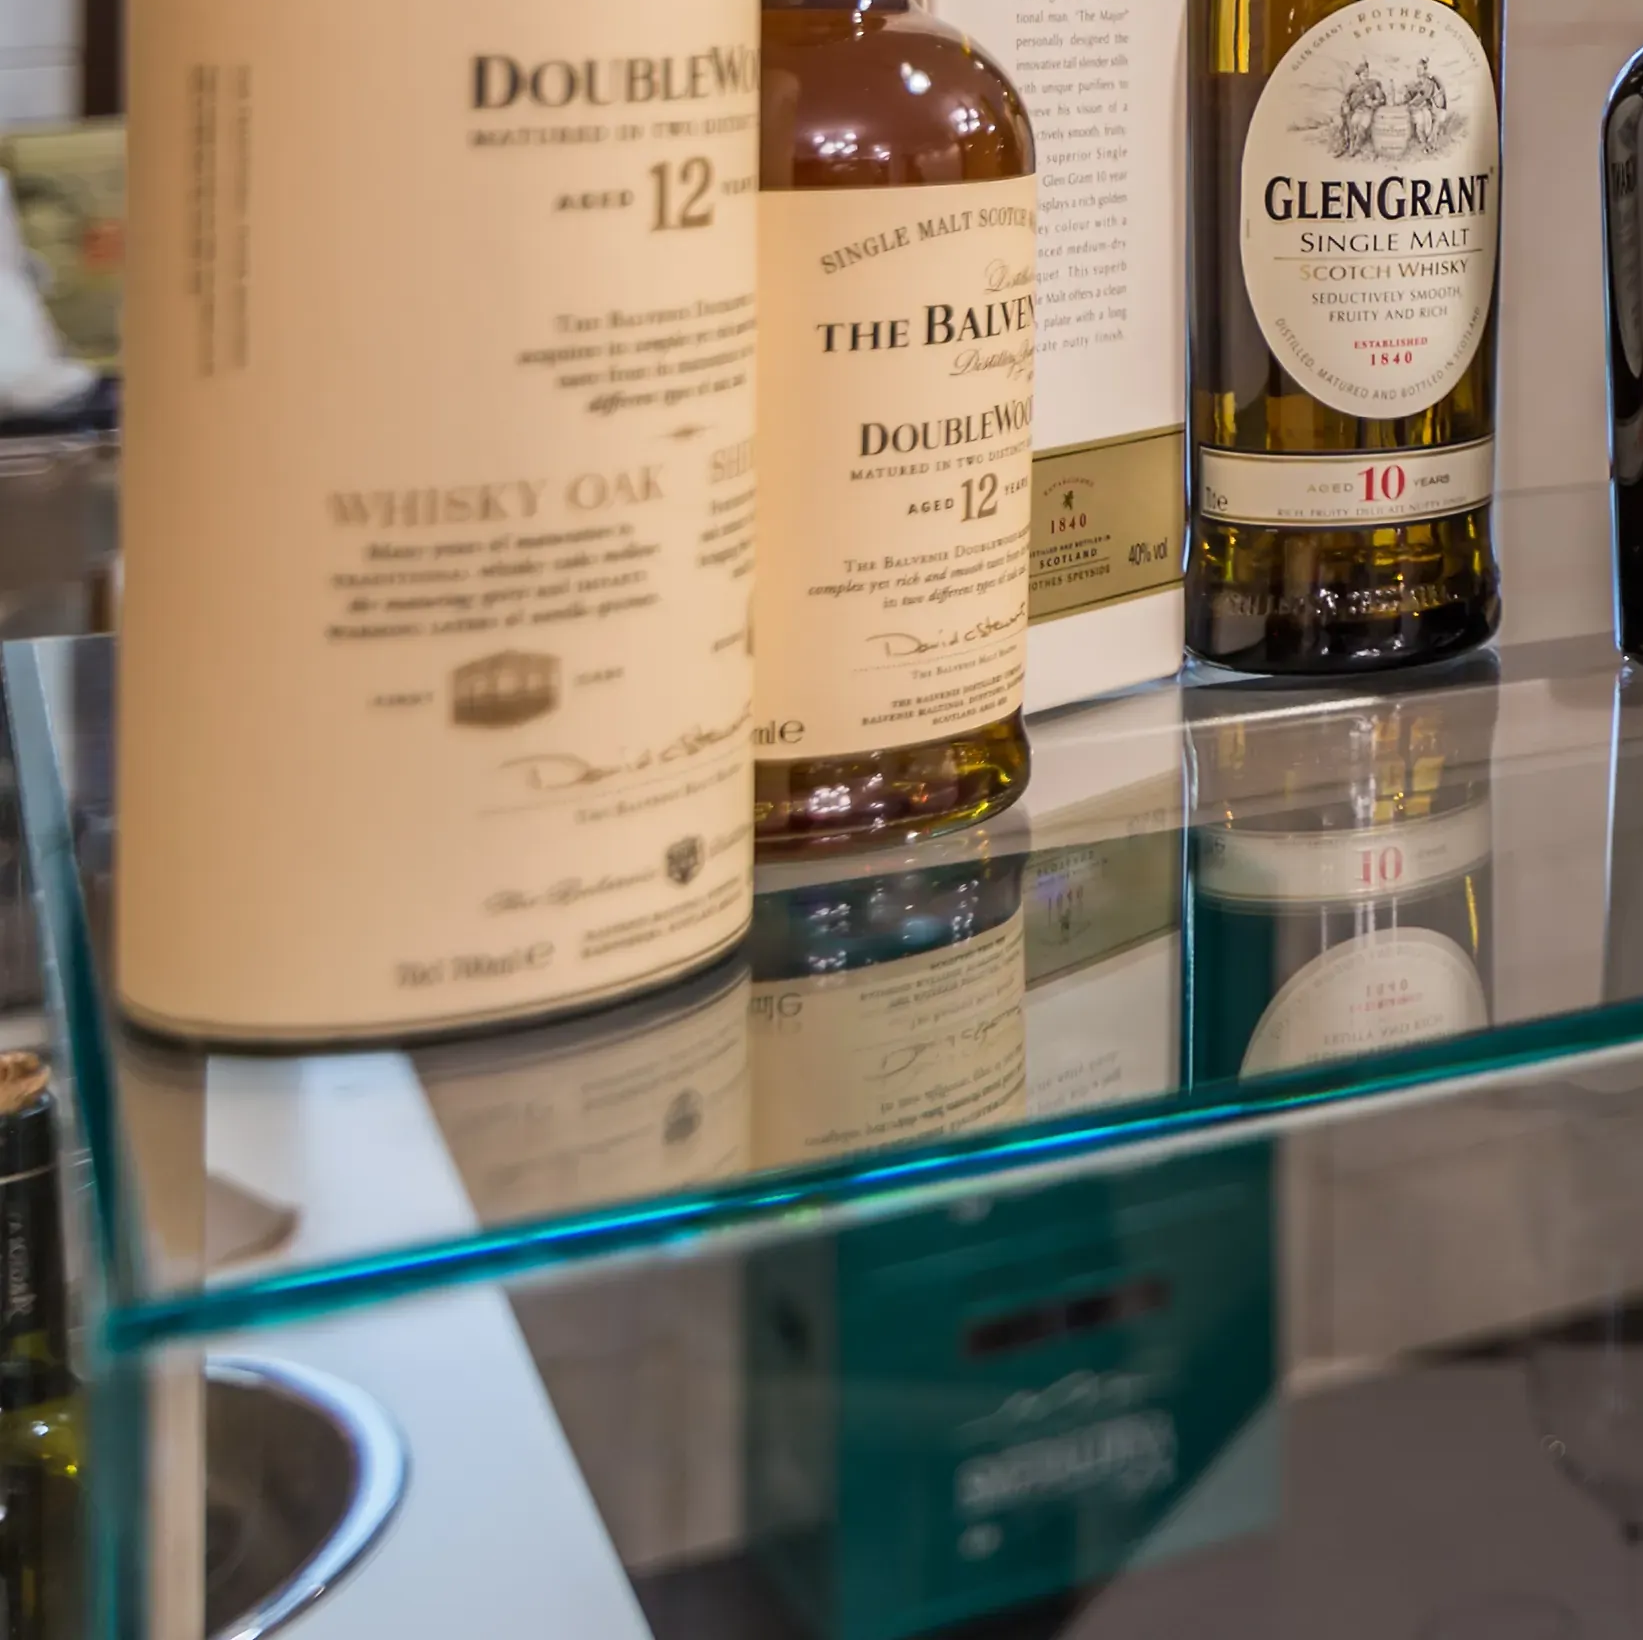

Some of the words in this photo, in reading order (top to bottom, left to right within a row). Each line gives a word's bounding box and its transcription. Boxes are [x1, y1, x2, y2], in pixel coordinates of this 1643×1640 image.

[1016, 11, 1043, 24] tional
[1313, 23, 1344, 50] GRANT
[1357, 7, 1433, 23] ROTHES
[1353, 22, 1437, 39] SPEYSIDE
[1016, 34, 1064, 50] personally
[1114, 31, 1130, 44] the
[1046, 150, 1092, 166] superior
[1096, 146, 1129, 163] Single
[1042, 174, 1065, 188] Glen
[1068, 171, 1093, 186] Grant
[647, 156, 716, 233] 12
[1078, 194, 1096, 207] rich
[1264, 174, 1489, 221] GLENGRANT
[1054, 218, 1090, 234] colour
[1094, 216, 1117, 228] with
[820, 226, 910, 274] SINGLE
[918, 210, 972, 241] MALT
[1066, 240, 1127, 256] medium-dry
[1301, 231, 1399, 253] SINGLE
[1410, 227, 1470, 250] MALT
[1068, 265, 1089, 279] This
[1092, 261, 1128, 279] superb
[1300, 262, 1391, 281] SCOTCH
[1398, 258, 1469, 278] WHISKY
[1046, 291, 1065, 305] Malt
[1311, 289, 1405, 306] SEDUCTIVELY
[1328, 309, 1380, 324] FRUITY
[1384, 307, 1415, 321] AND
[1419, 305, 1449, 319] RICH
[816, 319, 910, 353] THE
[1353, 336, 1428, 350] ESTABLISHED
[1369, 350, 1413, 367] 1840
[1317, 368, 1369, 399] MATURED
[1372, 388, 1398, 401] AND
[1401, 370, 1444, 399] BOTTLED
[850, 462, 929, 481] MATURED
[936, 459, 951, 473] IN
[955, 454, 984, 469] TWO
[565, 463, 664, 514] OAK
[1306, 483, 1354, 494] AGED
[1358, 464, 1406, 503] 10
[1413, 473, 1450, 488] YEARS
[907, 498, 953, 516] AGED
[960, 472, 998, 523] 12
[1050, 513, 1087, 534] 1840
[844, 559, 877, 573] THE
[884, 550, 949, 570] BALVENIE
[1039, 548, 1098, 570] SCOTLAND
[1029, 575, 1064, 592] OTHES
[1067, 563, 1111, 583] SPEYSIDE
[808, 579, 864, 599] complex
